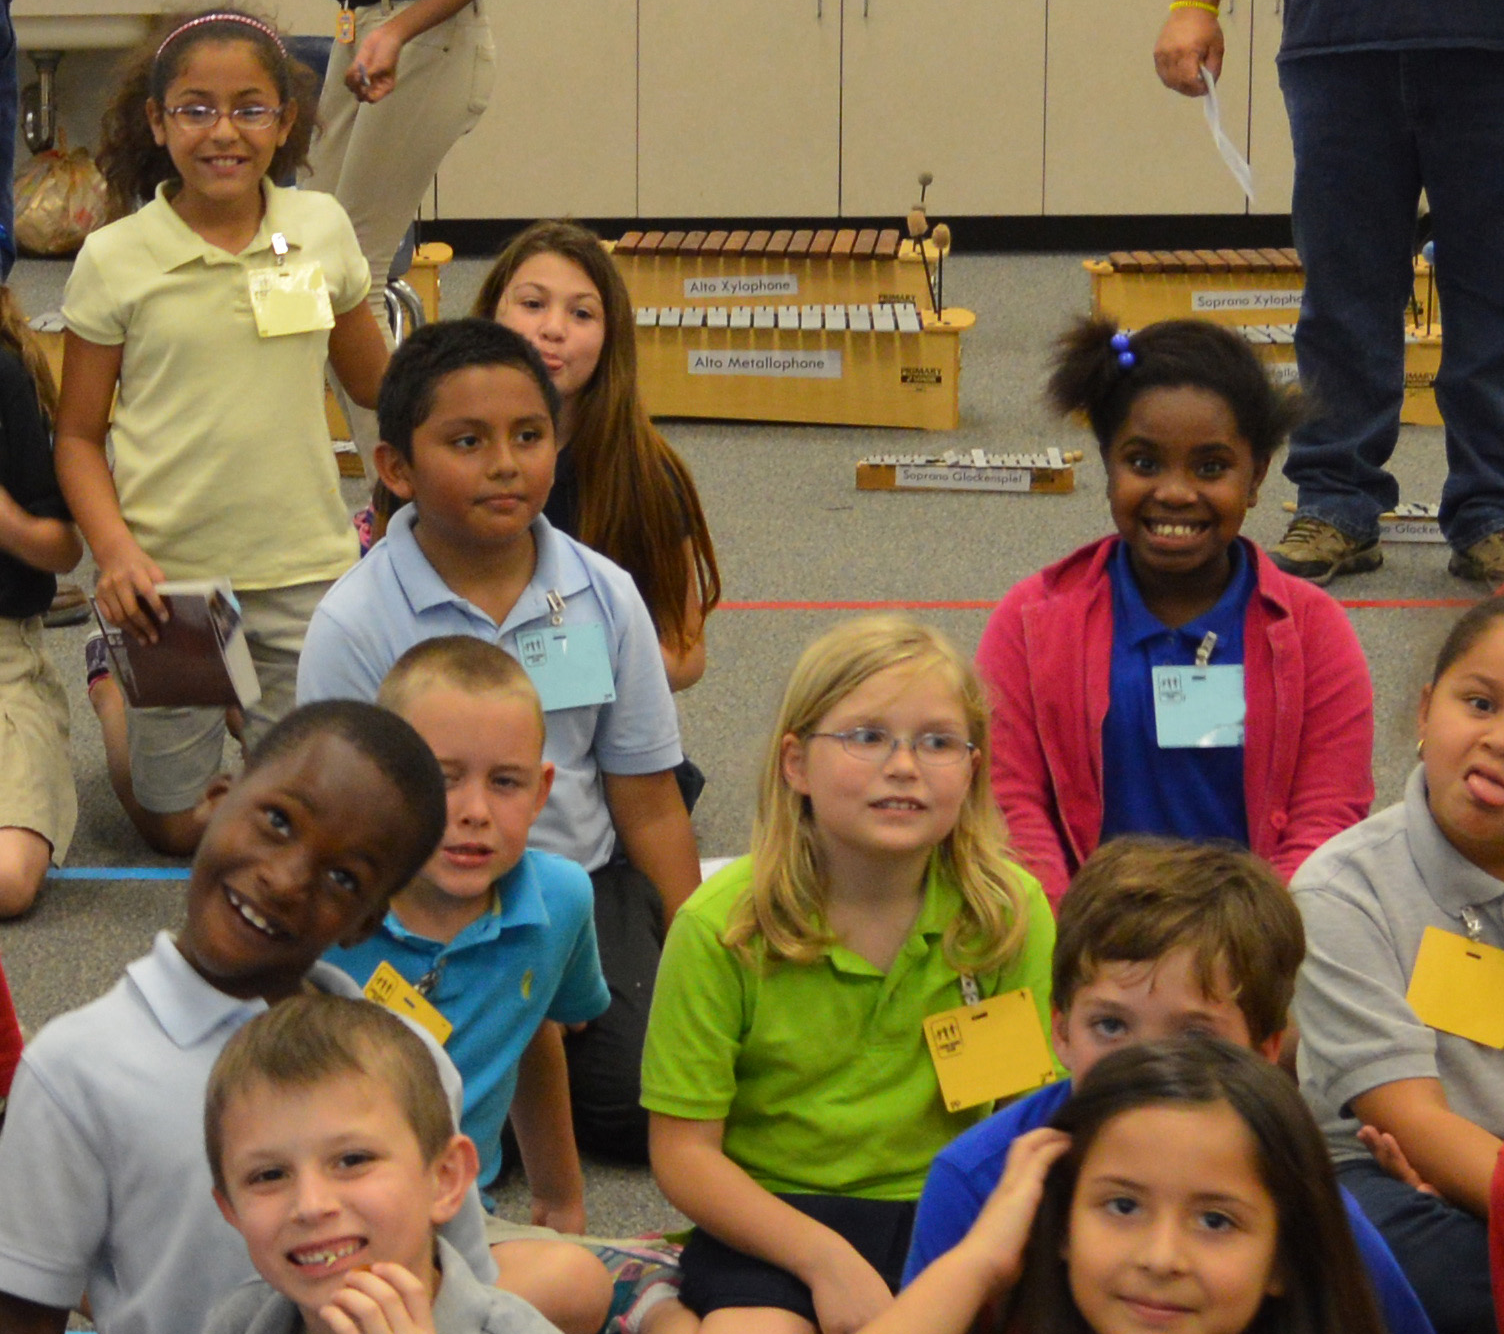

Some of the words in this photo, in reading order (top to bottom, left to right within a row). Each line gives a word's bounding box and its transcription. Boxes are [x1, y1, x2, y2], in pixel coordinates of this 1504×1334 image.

[690, 281, 717, 293] Alto
[722, 280, 791, 295] Xylophone
[1198, 295, 1249, 309] Soprano
[1254, 294, 1304, 308] Xylopho
[694, 356, 723, 369] Alto
[728, 355, 826, 371] Metallophone
[903, 470, 948, 485] Soprano
[952, 471, 1023, 486] Glockenspiel
[1395, 523, 1442, 536] Glocken
